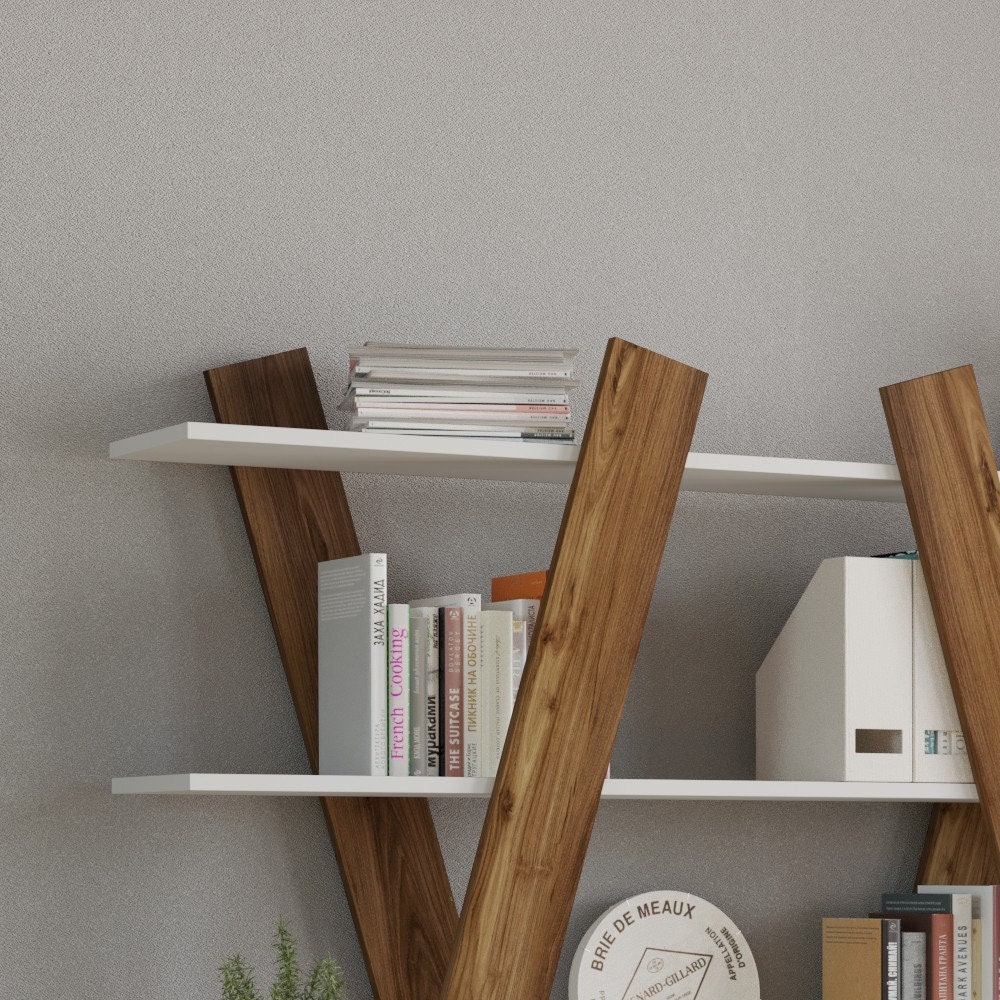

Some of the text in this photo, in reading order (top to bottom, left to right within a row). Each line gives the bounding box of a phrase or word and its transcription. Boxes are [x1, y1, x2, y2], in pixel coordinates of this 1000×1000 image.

[373, 578, 385, 646] ЗАХА ХАДИД
[389, 628, 407, 759] French Cooking
[467, 615, 477, 732] ПИКНИК НА ОБОЧИНЕ
[448, 687, 460, 770] THE SUITCASE
[591, 900, 697, 972] BRIE DE MEAUX
[704, 926, 737, 981] APPELLATION
[719, 926, 746, 968] D'ORIGINE
[938, 934, 947, 964] ГРАНТА
[957, 925, 967, 974] AVENUES
